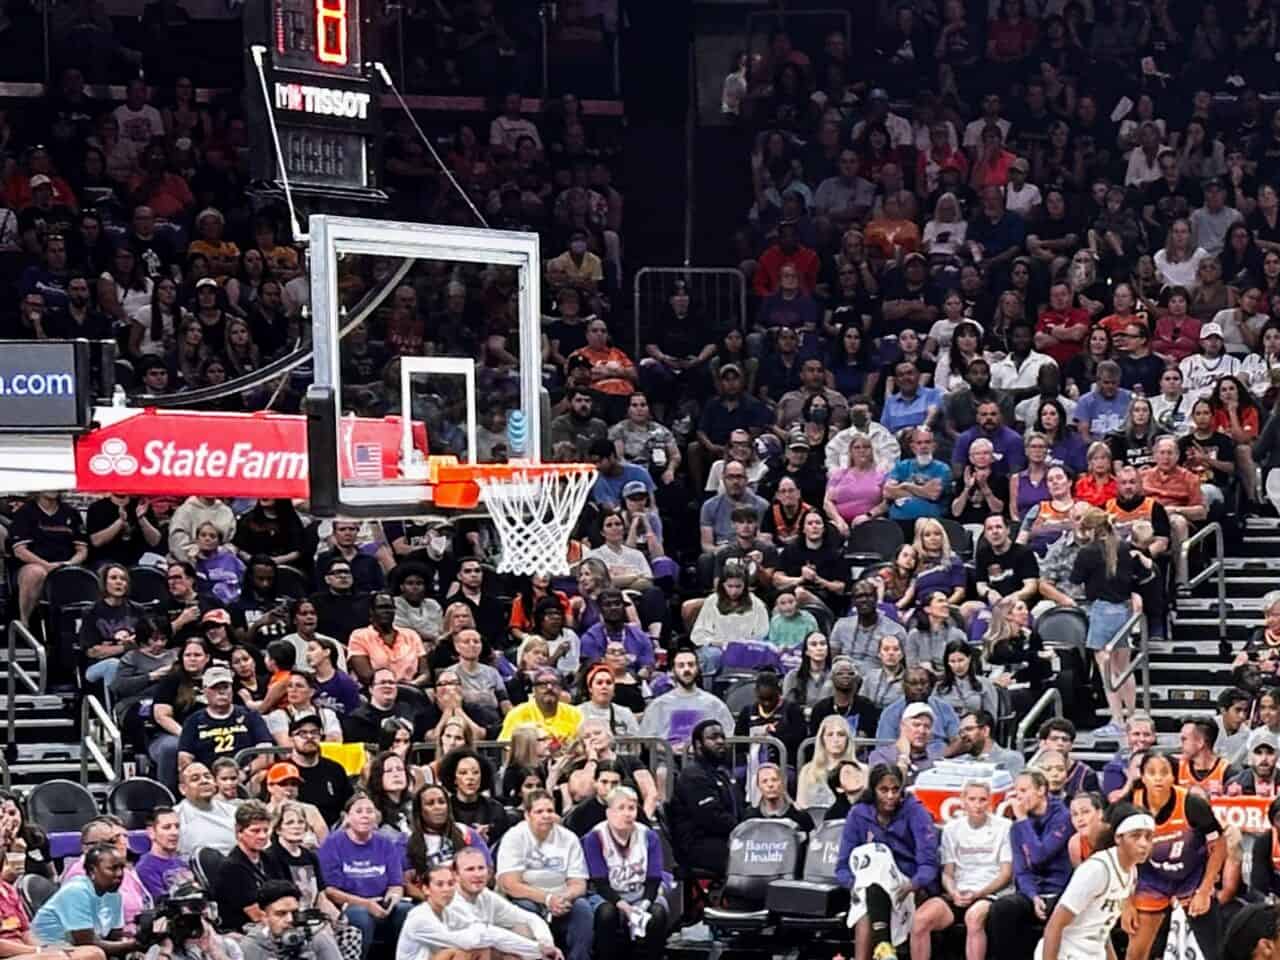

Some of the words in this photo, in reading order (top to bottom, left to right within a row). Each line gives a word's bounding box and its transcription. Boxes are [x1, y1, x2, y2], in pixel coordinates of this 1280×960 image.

[301, 85, 370, 119] TISSOT
[214, 735, 234, 752] 22
[745, 840, 786, 851] Banner
[744, 851, 782, 863] Health
